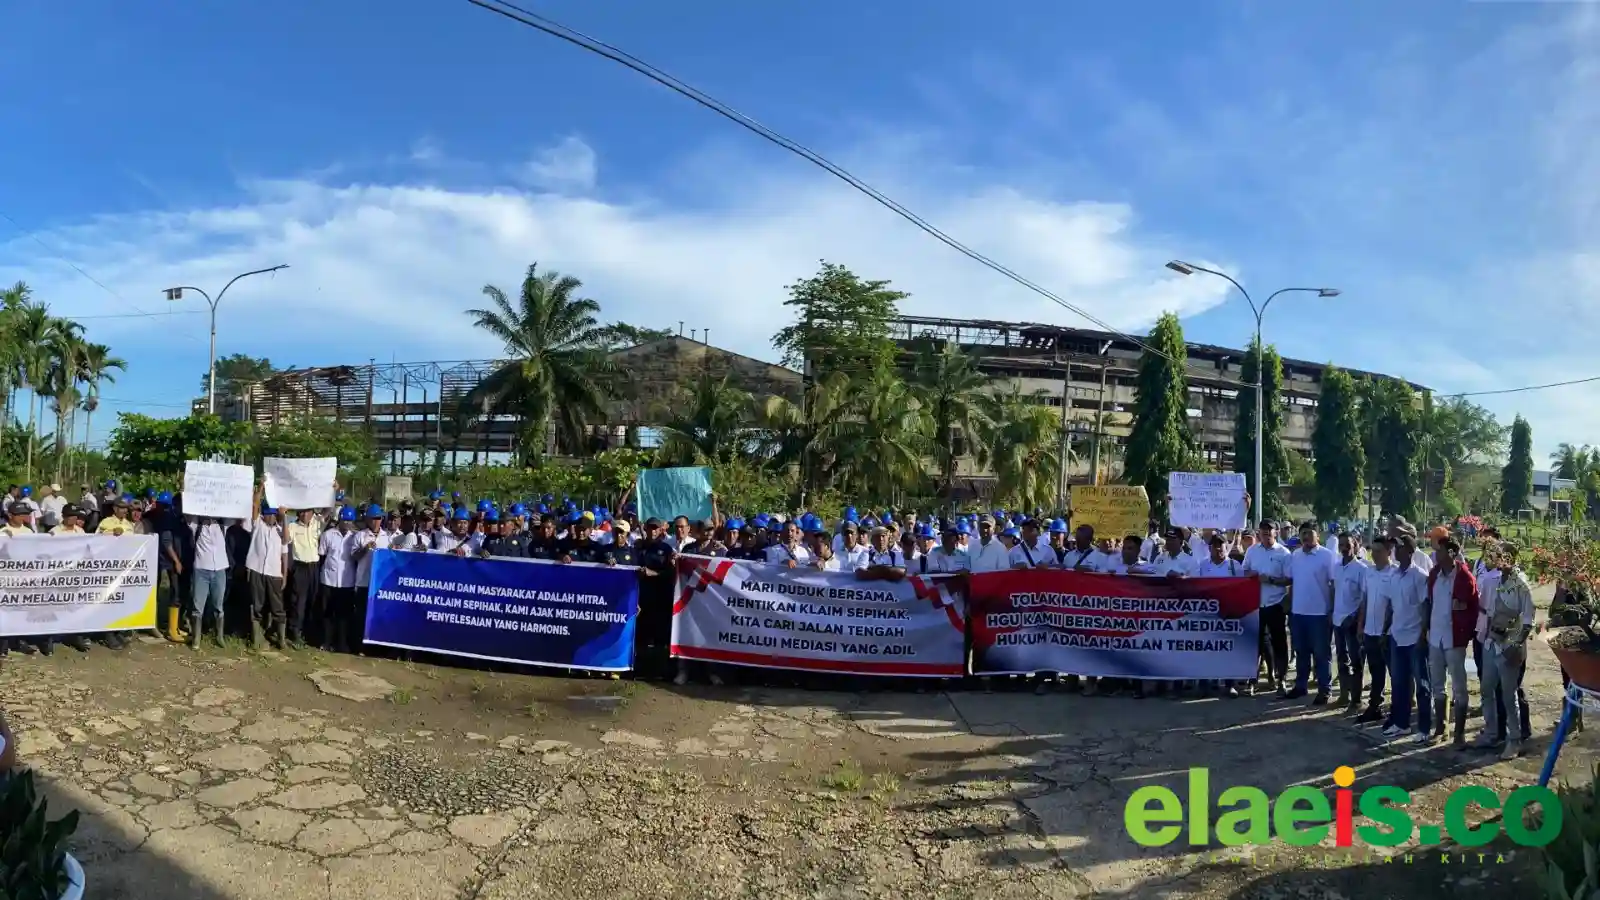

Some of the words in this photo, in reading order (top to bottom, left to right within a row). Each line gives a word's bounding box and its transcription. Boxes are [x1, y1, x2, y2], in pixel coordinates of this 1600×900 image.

[41, 576, 80, 586] HARUS
[83, 574, 151, 585] DIHENIKAN.
[398, 576, 456, 592] PERUSAHAAN
[456, 583, 476, 594] DAN
[477, 585, 536, 600] MASYARAKAT
[537, 591, 575, 603] ADALAH
[576, 594, 608, 606] MITRA.
[740, 580, 774, 593] MARI
[778, 583, 825, 598] DUDUK
[23, 592, 75, 603] MELALUI
[78, 591, 125, 601] MEDASI
[377, 590, 413, 602] JANGAN
[414, 594, 432, 605] ADA
[433, 597, 462, 609] KLAIM
[505, 603, 529, 616] KAMI
[529, 606, 554, 618] AJAK
[555, 609, 594, 621] MEDIASI
[595, 612, 628, 624] UNTUK
[1010, 593, 1059, 607] TOLAK
[1060, 594, 1110, 609] KLAIM
[1111, 598, 1179, 612] SEPIHAK
[1180, 599, 1219, 613] ATAS
[727, 596, 796, 613] HENTIKAN
[800, 603, 843, 617] KLAIM
[847, 607, 911, 621] SEPIHAK,
[426, 611, 492, 628] PENYELESAIAN
[493, 618, 519, 631] YANG
[520, 621, 571, 636] HARMONIS.
[730, 615, 761, 628] KITA
[763, 618, 795, 631] CARI
[798, 621, 844, 635] JALAN
[848, 625, 905, 637] TENGAH
[987, 613, 1021, 627] HGU
[1063, 615, 1138, 630] BERSAMA
[1139, 619, 1174, 631] KITA
[1176, 620, 1243, 635] MEDIASI,
[718, 631, 778, 647] MELALUI
[780, 637, 837, 652] MEDIASI
[841, 643, 879, 655] YANG
[882, 645, 916, 655] ADIL
[997, 632, 1048, 646] HUKUM
[1050, 633, 1111, 649] ADALAH
[1112, 638, 1163, 651] JALAN
[1166, 640, 1234, 651] TERBAIK!
